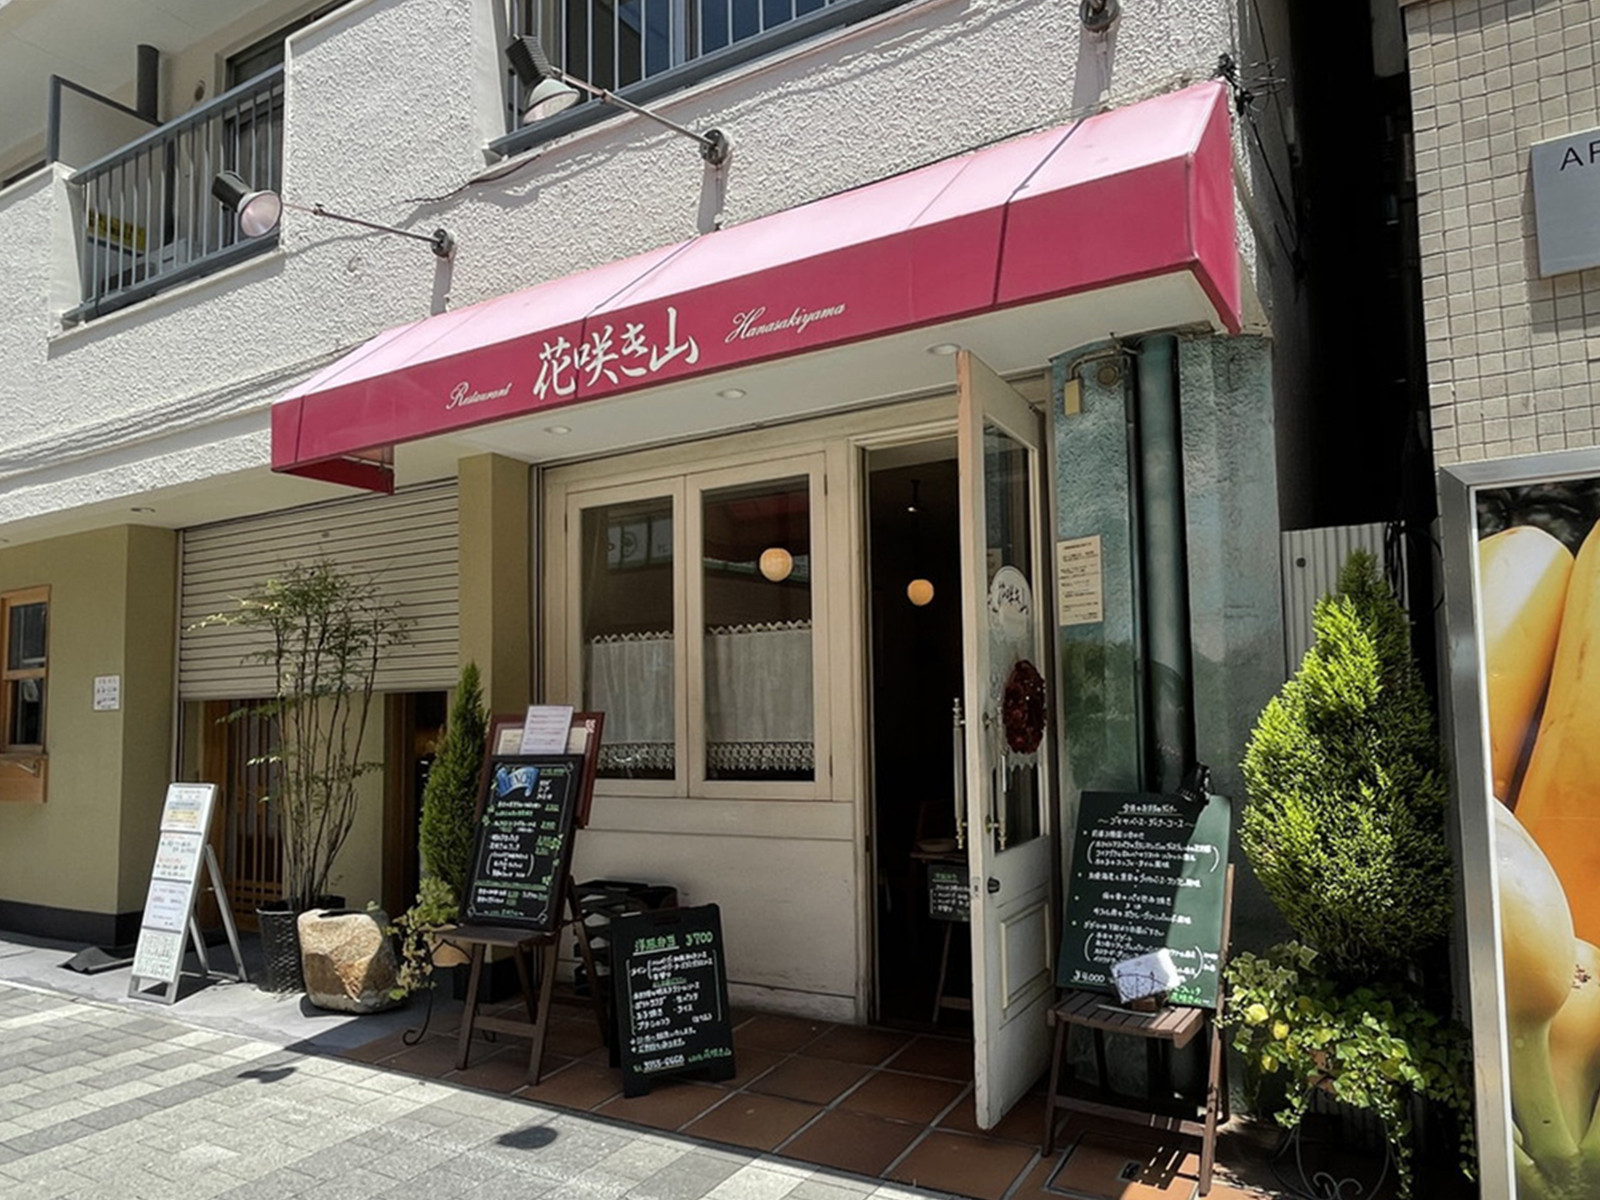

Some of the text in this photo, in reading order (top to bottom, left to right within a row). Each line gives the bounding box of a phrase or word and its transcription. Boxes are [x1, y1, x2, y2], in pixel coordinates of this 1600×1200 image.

[533, 307, 699, 400] 花咲き山
[725, 302, 846, 344] Hanasakiyama
